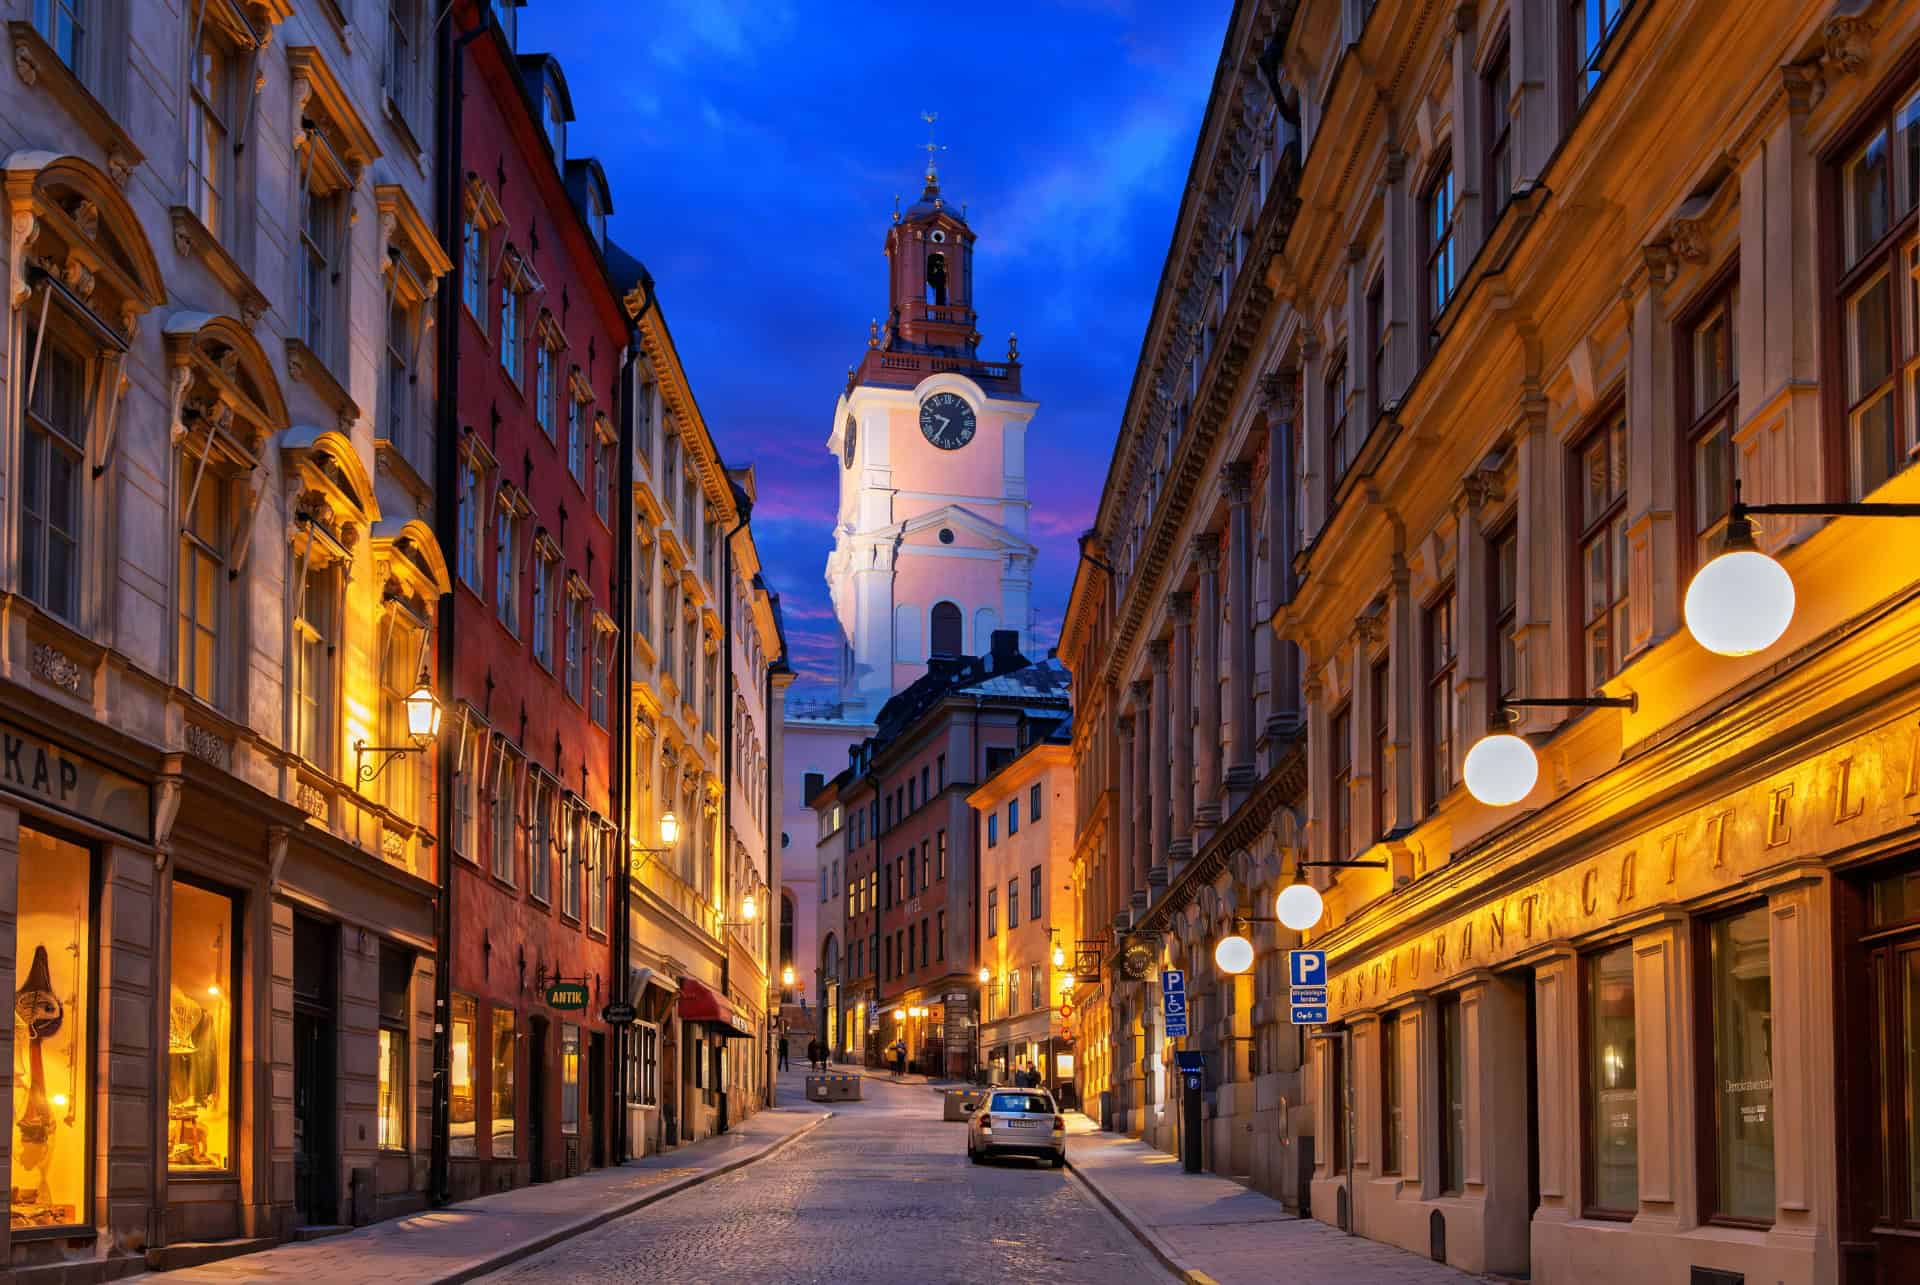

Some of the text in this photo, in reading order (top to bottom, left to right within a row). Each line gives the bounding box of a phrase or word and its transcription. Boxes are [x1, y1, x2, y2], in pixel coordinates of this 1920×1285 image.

[4, 732, 77, 801] KAP
[1327, 892, 1539, 1010] ESTAURANT
[1167, 972, 1181, 991] P
[1299, 953, 1320, 984] P
[552, 991, 582, 1005] ANTIK
